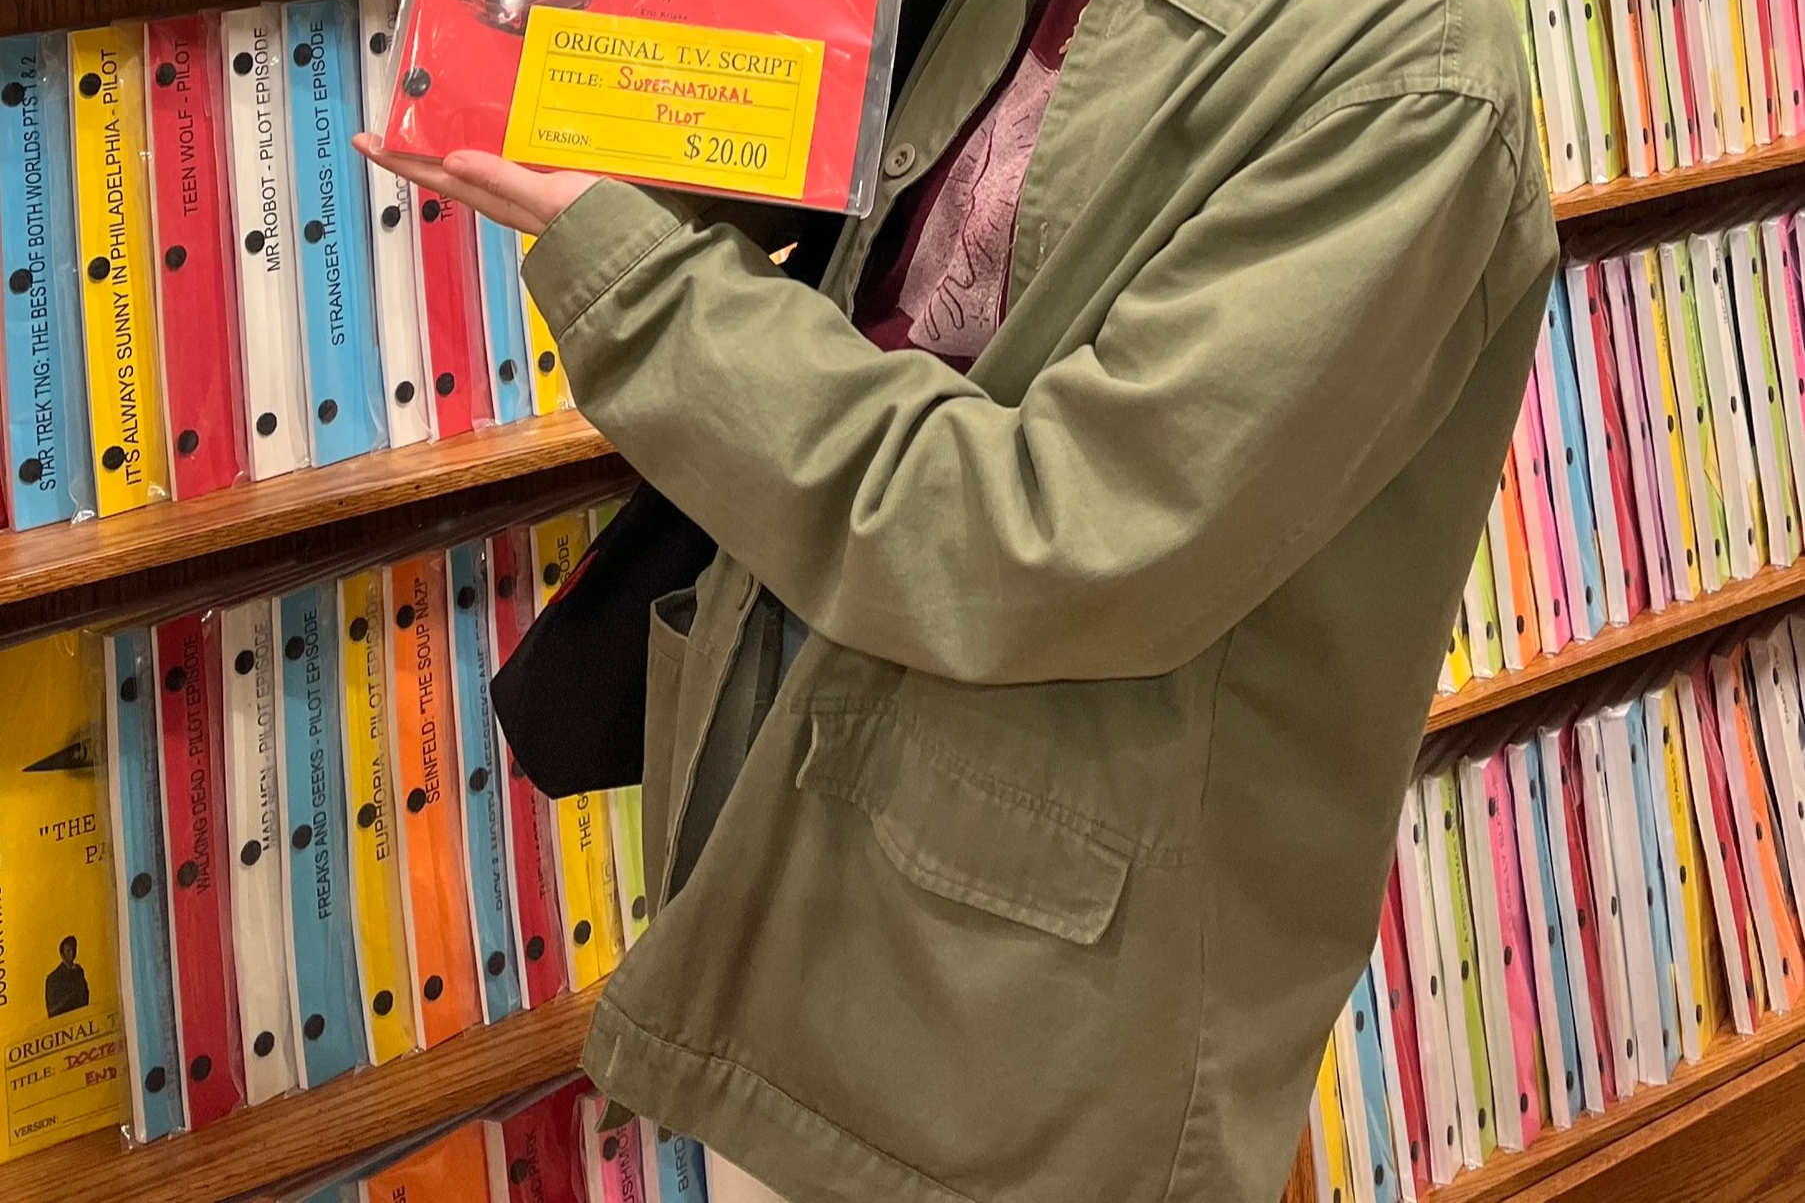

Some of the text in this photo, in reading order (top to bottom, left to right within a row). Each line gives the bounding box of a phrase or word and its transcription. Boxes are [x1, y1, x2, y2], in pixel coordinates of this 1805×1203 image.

[21, 54, 36, 65] 2
[21, 67, 36, 79] &
[554, 30, 797, 78] ORIGINAL T.V. SCRIPT
[548, 66, 753, 105] TITLE: SUPERNATURAL
[22, 96, 40, 128] PTS
[174, 41, 198, 218] TEEN WOLF PILOT
[656, 104, 706, 126] PILOT
[253, 26, 281, 272] MR ROBOT PILOT EPISODE
[537, 129, 592, 147] VERSION:
[23, 130, 42, 200] WORLDS
[310, 19, 344, 347] STRANGER THINGS: PILOT EPISODE
[26, 202, 45, 251] BOTH
[28, 253, 45, 277] OF
[101, 48, 142, 486] IT'S ALWAYS SUNNY IN PHILADELPHIA PILOT
[30, 277, 48, 320] BEST
[31, 321, 49, 356] THE
[33, 357, 50, 400] TNG:
[34, 400, 54, 446] TREK
[38, 447, 56, 491] STAR
[254, 620, 273, 754] PILOT EPISODE
[413, 577, 441, 804] SEINFELD: "THE SOUP NAZI"
[183, 633, 211, 894] WALKING DEAD PILOT EPISODE
[304, 608, 332, 921] FREAKS AND GEEKS PILOT EPISODE
[39, 814, 97, 842] "THE
[580, 810, 591, 853] THE
[8, 1021, 100, 1063] ORIGINAL
[10, 1065, 57, 1091] TITLE:
[84, 1067, 118, 1085] END
[13, 1116, 60, 1139] VERSION:
